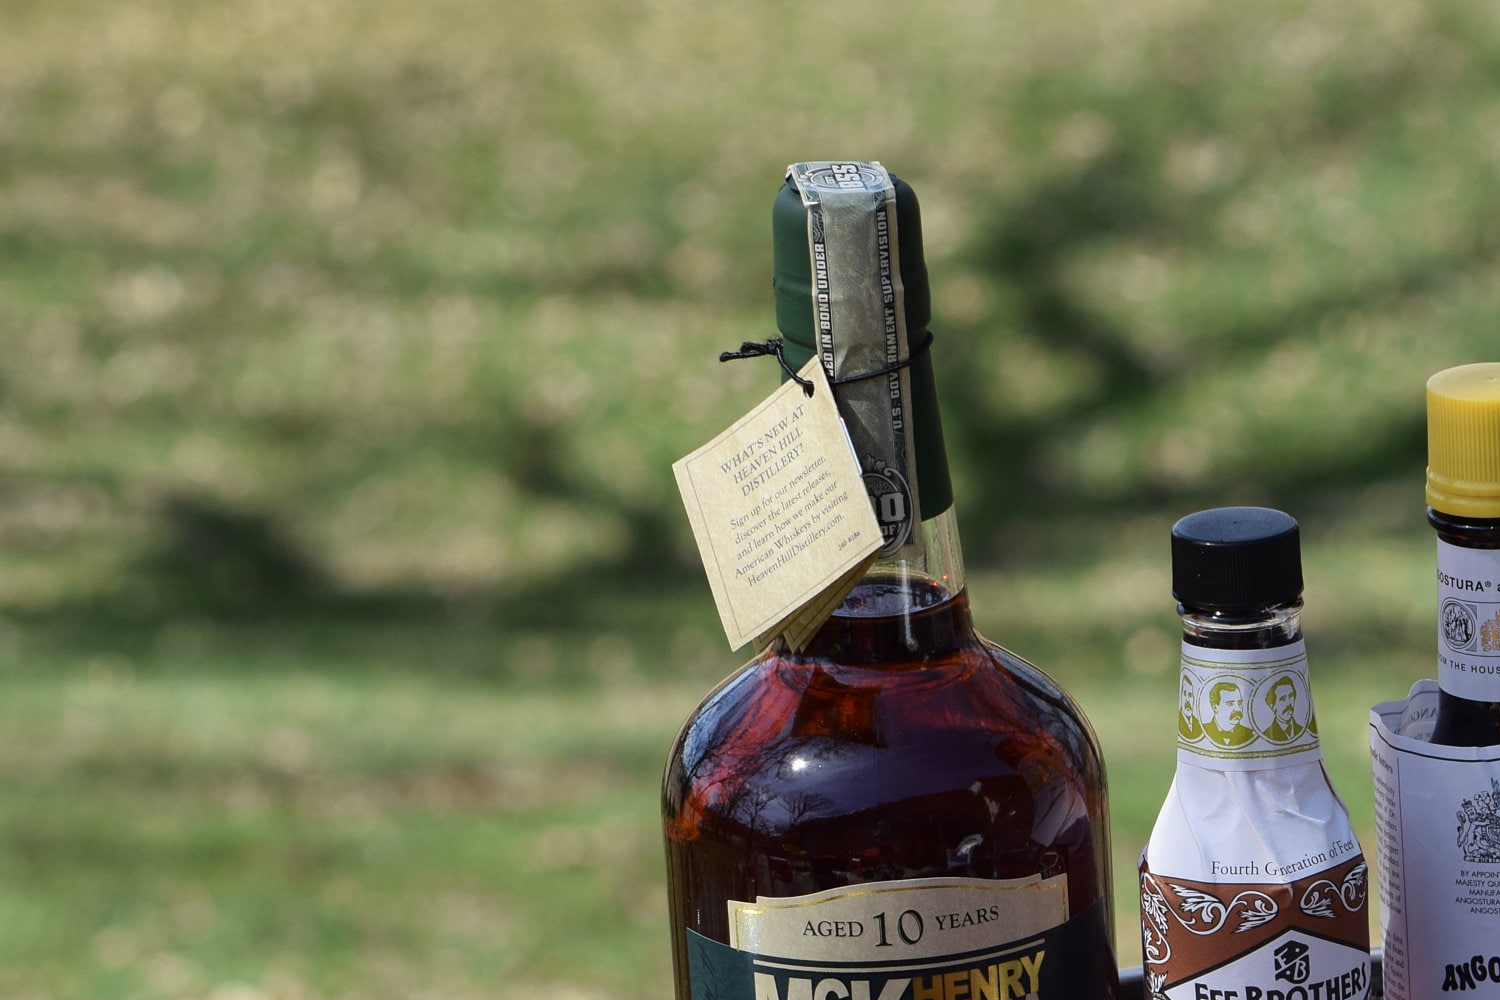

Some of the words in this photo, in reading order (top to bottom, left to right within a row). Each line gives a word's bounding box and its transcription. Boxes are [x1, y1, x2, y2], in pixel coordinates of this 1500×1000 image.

[814, 243, 829, 289] UNDER
[876, 211, 894, 305] SUPERVISION
[817, 293, 831, 330] BOND
[821, 333, 832, 349] IN
[720, 438, 764, 474] WHAT'S
[764, 417, 788, 443] NEW
[791, 404, 804, 423] AT
[891, 403, 903, 430] U.S.
[733, 445, 777, 484] HEAVEN
[778, 427, 803, 452] HILL
[741, 443, 804, 497] DISTILLERY?
[730, 513, 749, 530] Sign
[750, 505, 761, 517] up
[761, 495, 773, 509] for
[774, 485, 787, 499] our
[789, 455, 827, 488] newsletter,
[734, 518, 767, 544] discover
[768, 507, 781, 521] the
[781, 492, 802, 511] latest
[802, 470, 831, 496] releases,
[735, 548, 774, 578] American
[774, 521, 811, 550] Whiskeys
[811, 512, 822, 526] by
[821, 491, 848, 516] visiting
[736, 541, 753, 560] and
[753, 530, 775, 549] learn
[774, 517, 791, 534] how
[792, 508, 804, 521] we
[804, 493, 823, 512] make
[824, 480, 838, 496] our
[746, 513, 845, 587] HeavenHillDistillery.com.
[1450, 660, 1466, 672] THE
[1211, 860, 1259, 876] Fourth
[1329, 843, 1338, 859] of
[1455, 879, 1486, 887] MAJESTY
[1460, 869, 1470, 877] BY
[802, 918, 864, 939] AGED
[872, 908, 925, 948] 10
[935, 904, 999, 932] YEARS
